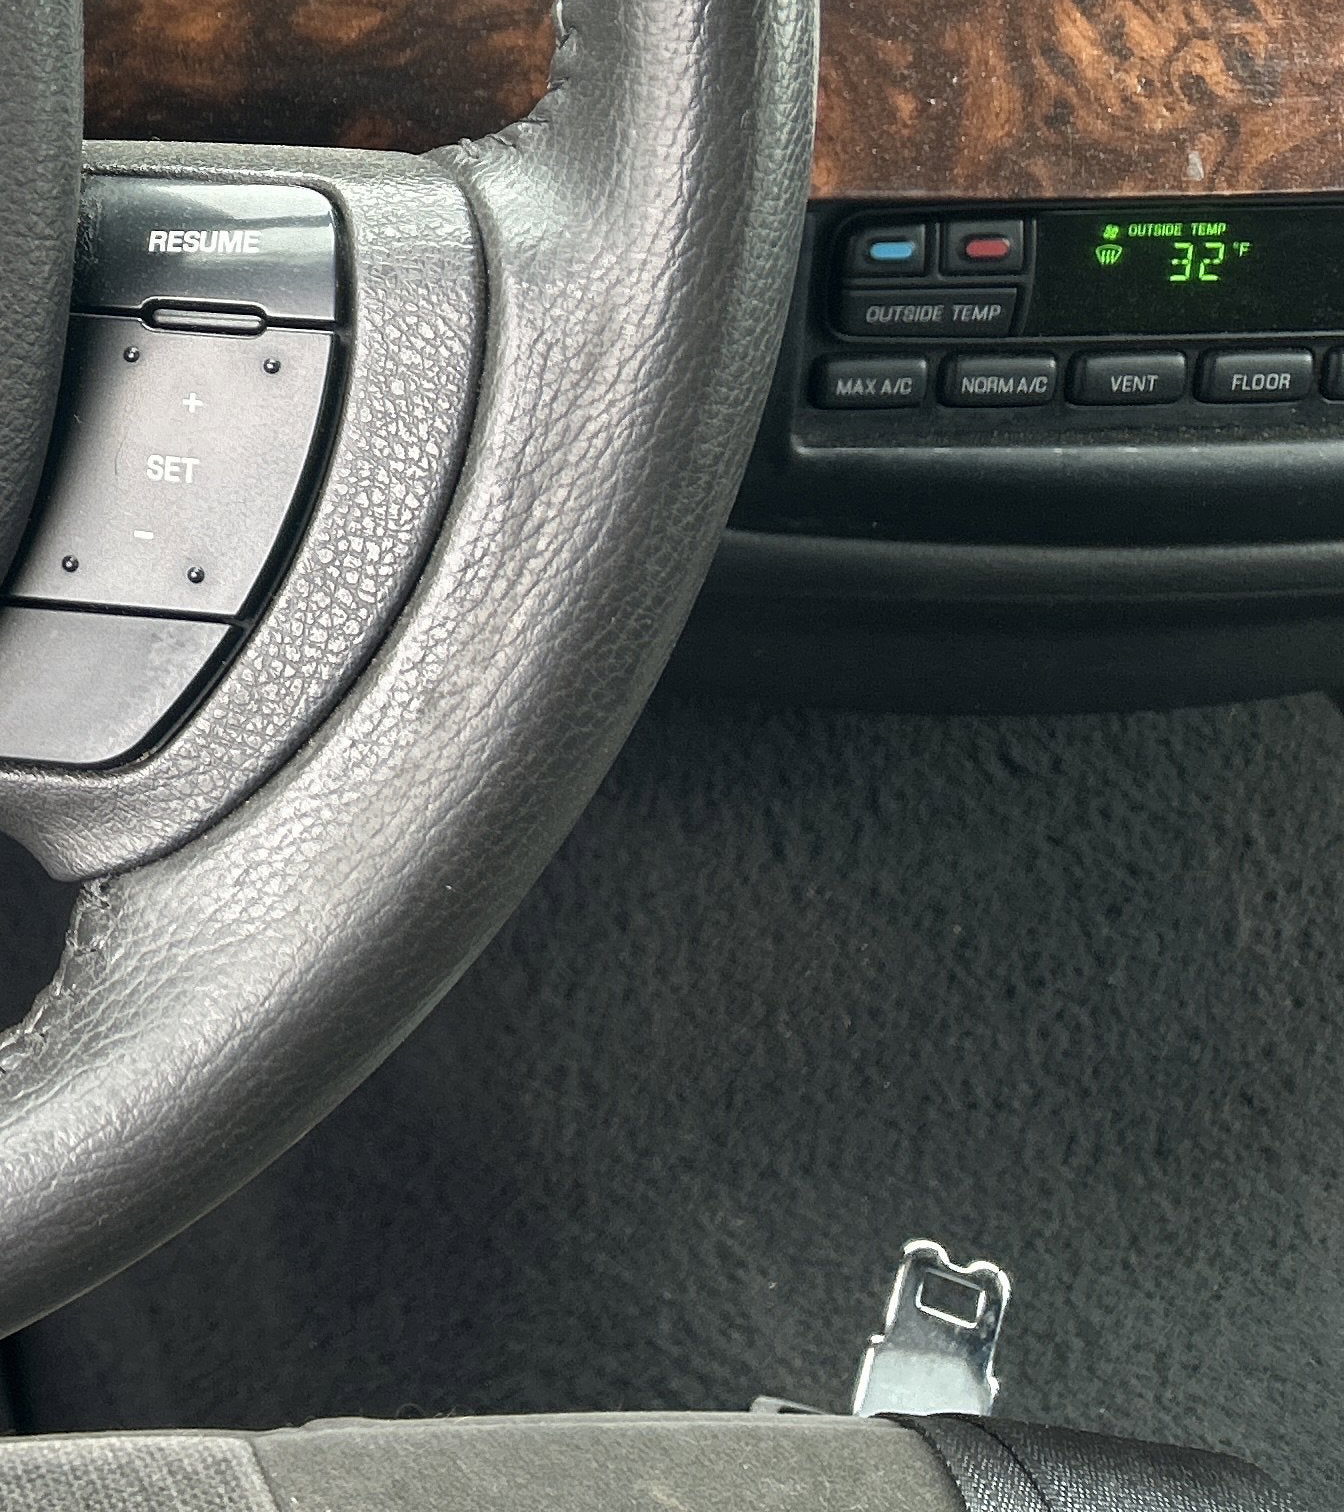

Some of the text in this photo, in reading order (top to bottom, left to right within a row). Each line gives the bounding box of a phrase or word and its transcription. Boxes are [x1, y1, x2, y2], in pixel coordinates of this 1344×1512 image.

[1190, 222, 1228, 236] TEMP
[147, 230, 263, 254] RESUME
[1169, 242, 1226, 282] 32
[865, 304, 1003, 324] OUTSIDE TEMP
[836, 377, 913, 396] MAX A/C
[960, 375, 1049, 394] NORM A/C
[1110, 375, 1159, 393] VENT
[1231, 372, 1292, 392] FLOOR
[146, 454, 200, 484] SET
